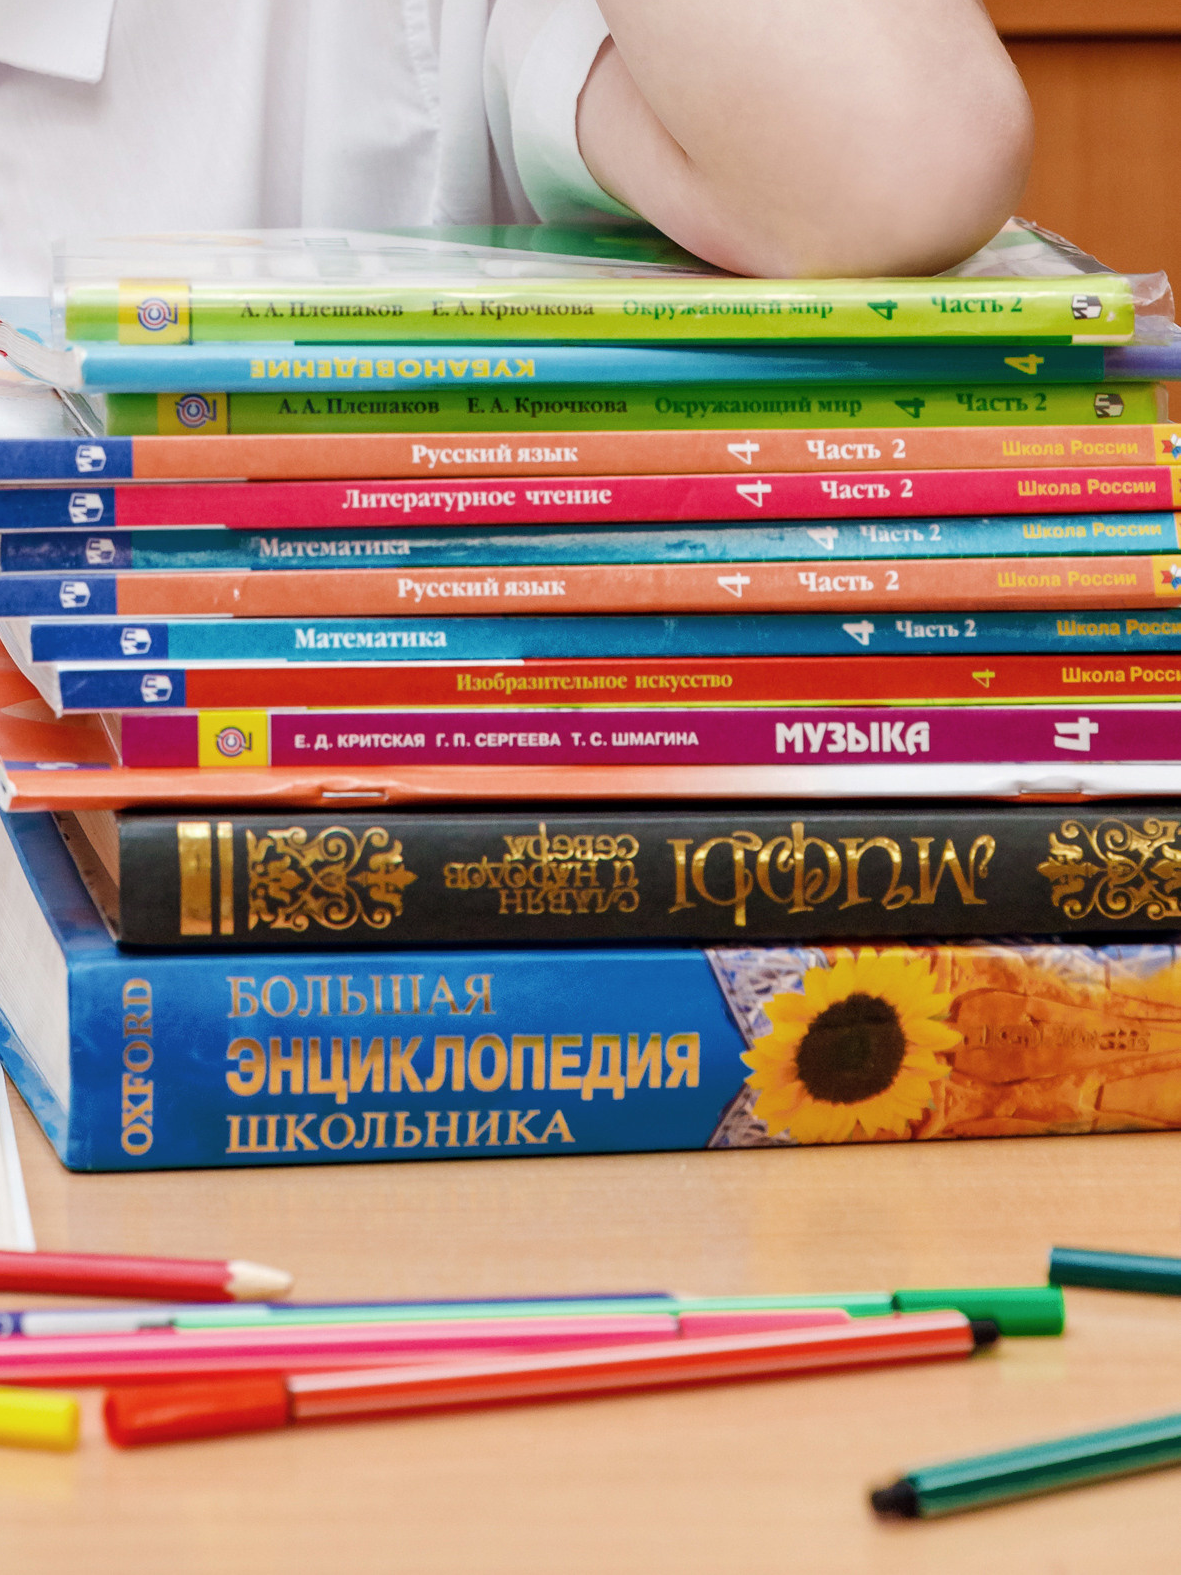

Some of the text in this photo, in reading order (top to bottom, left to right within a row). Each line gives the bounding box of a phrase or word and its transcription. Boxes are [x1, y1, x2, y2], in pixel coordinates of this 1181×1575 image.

[240, 295, 1023, 321] А. А. Плешаков Е. А. Крючкова Окружающий мир 4 Часть 2
[250, 353, 1045, 378] КУБАНОВЕДЕНИЕ 4
[278, 393, 1047, 419] А. А. Плешаков Е. А. Крючкова Окружающий мир 4 Часть 2
[411, 438, 1139, 469] Русский язык 4 Часть 2 Школа России
[341, 478, 1157, 513] Литературное чтение 4 Часть 2 Школа России
[258, 522, 1162, 558] Математика 4 Часть 2 Школа России
[397, 570, 1137, 603] Русский язык 4 Часть 2 Школа России
[294, 627, 447, 649] Математика
[842, 619, 875, 646] 4
[895, 620, 960, 638] Часть
[964, 619, 977, 637] 2
[1056, 620, 1121, 636] Школа
[456, 672, 628, 695] Изобразительное
[634, 673, 733, 692] искусство
[972, 669, 995, 689] 4
[1062, 667, 1126, 683] Школа
[294, 731, 699, 750] Е. Д. КРИТСКАЯ Г. П. СЕРГЕЕВА Т. С. ШМАГИНА
[775, 716, 1099, 756] МУЗЫКА 4
[225, 973, 496, 1018] БОЛЬШАЯ
[120, 977, 155, 1156] OXFORD
[225, 1031, 701, 1105] ЭНЦИКЛОПЕДИЯ
[225, 1109, 576, 1154] ШКОЛЬНИКА
